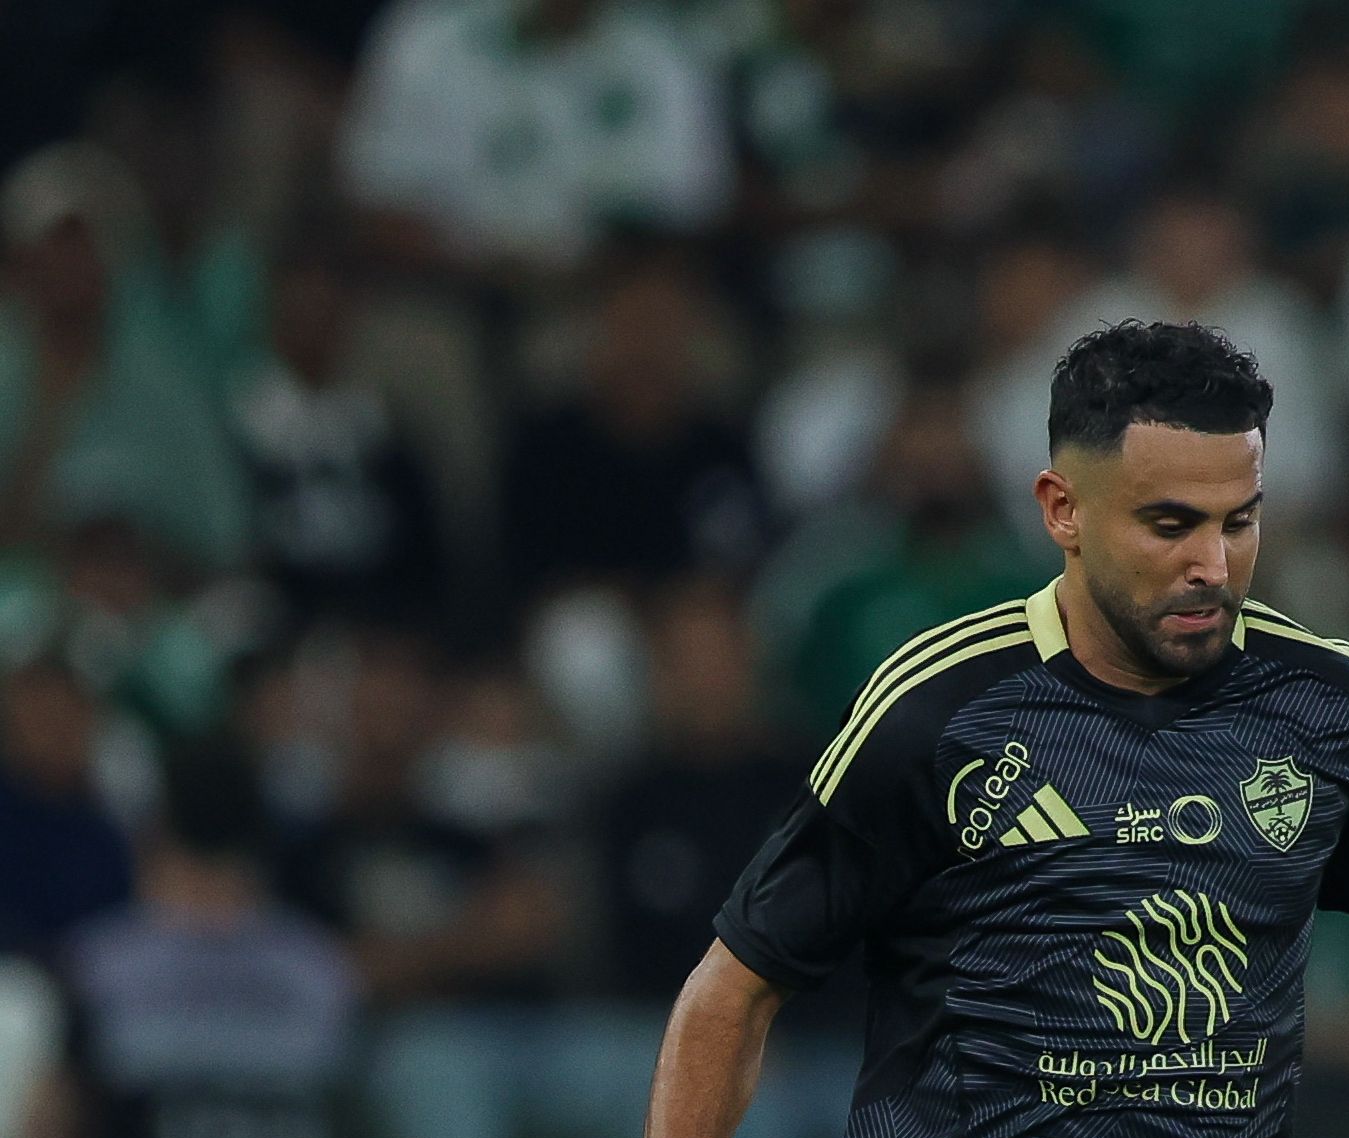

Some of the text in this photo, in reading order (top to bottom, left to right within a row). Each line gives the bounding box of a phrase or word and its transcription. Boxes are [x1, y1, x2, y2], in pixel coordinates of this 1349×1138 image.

[1114, 802, 1161, 826] سرك
[1116, 825, 1164, 844] SIRC
[1217, 1037, 1268, 1076] البحر
[1039, 1079, 1097, 1107] Red
[1170, 1077, 1259, 1110] Global
